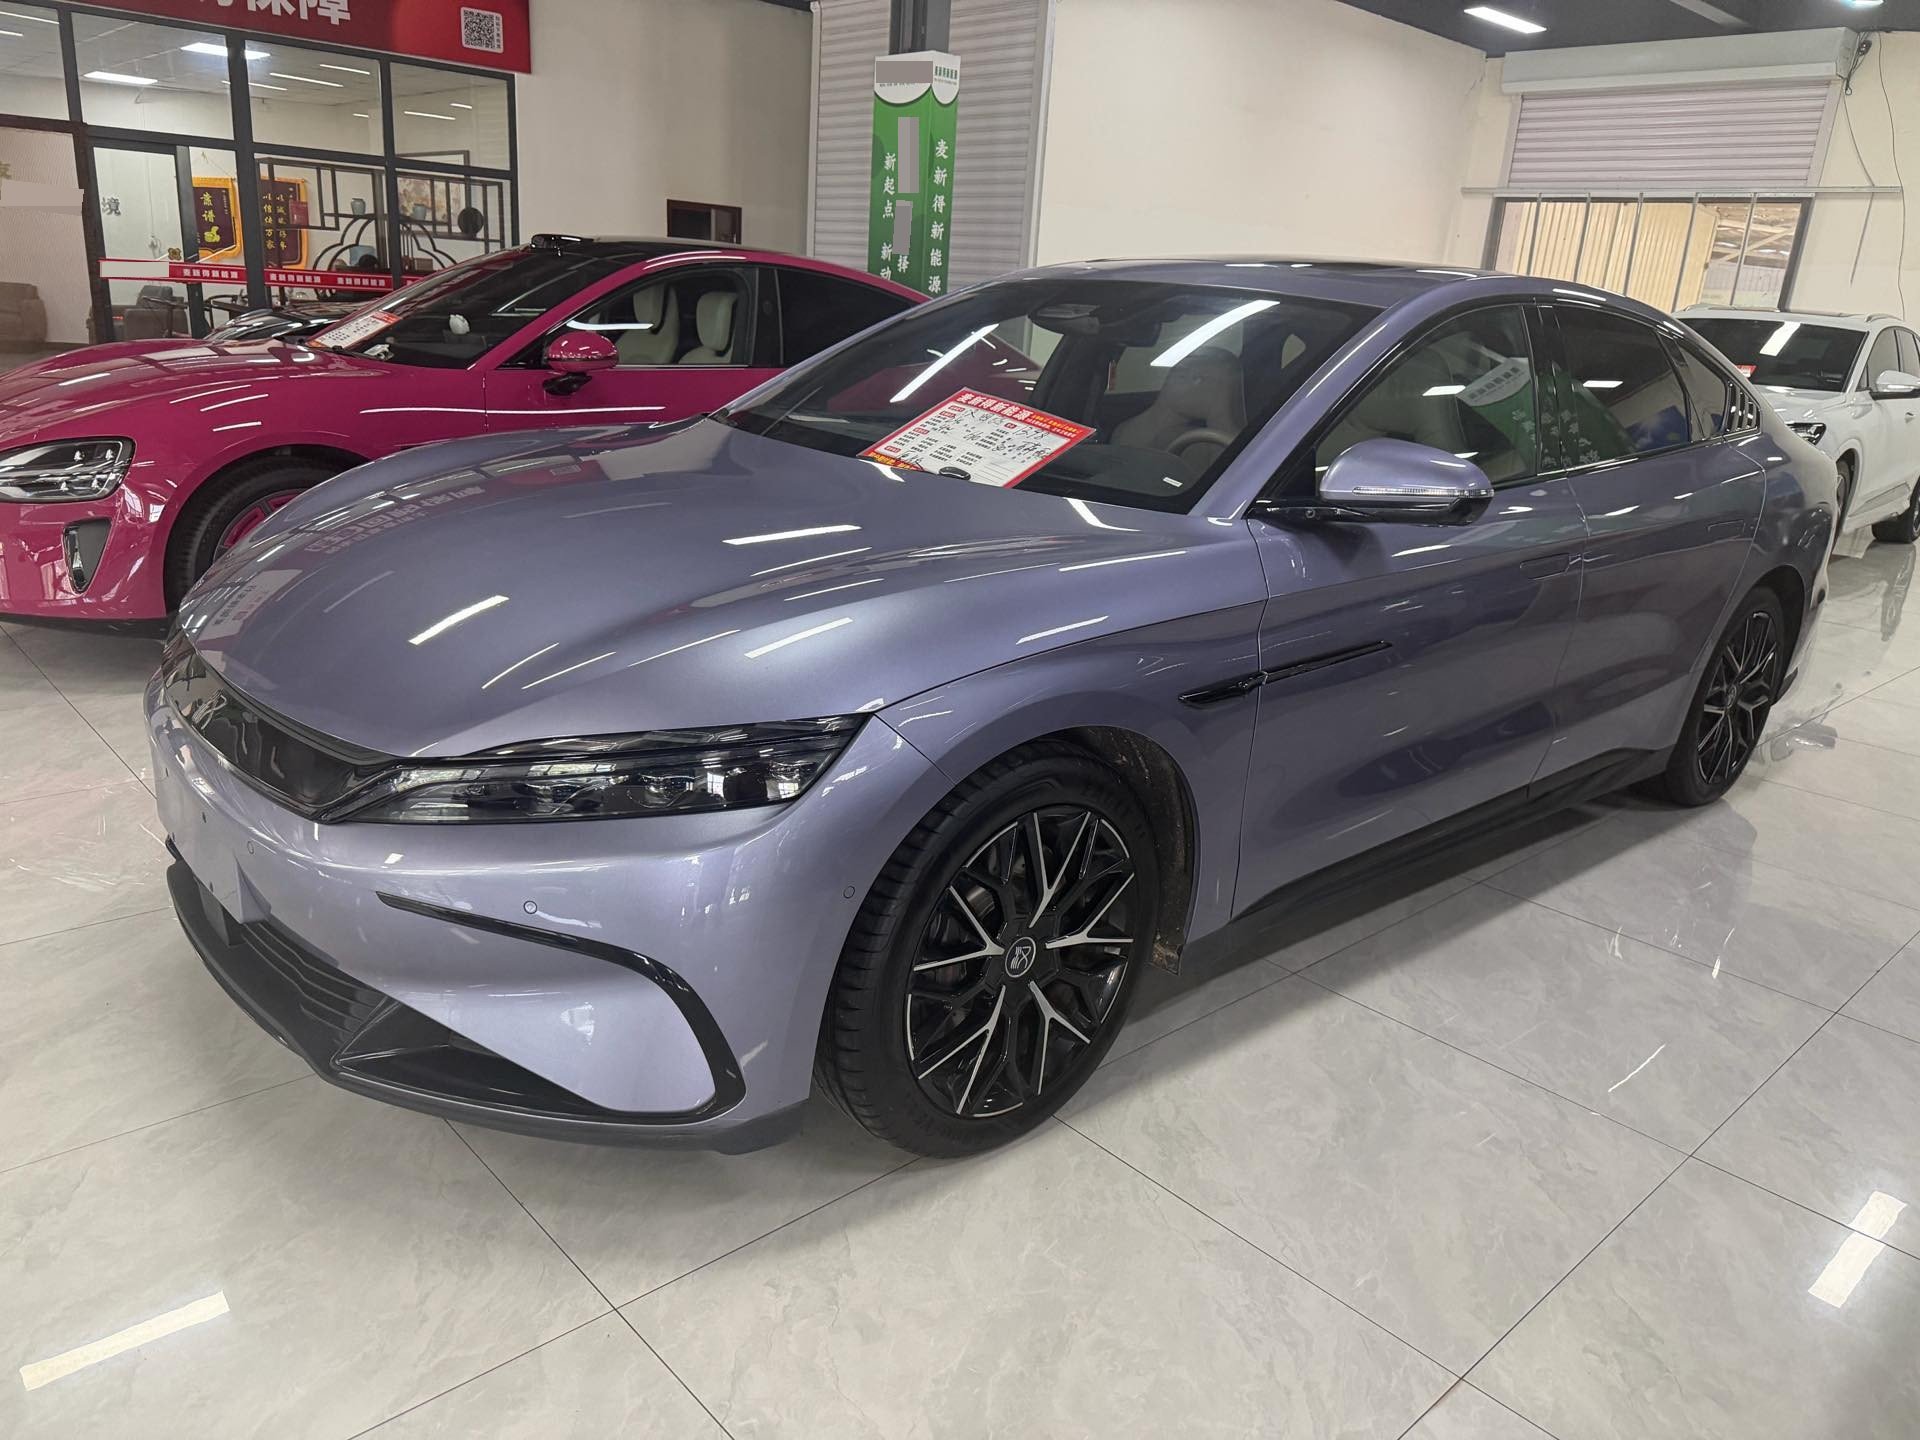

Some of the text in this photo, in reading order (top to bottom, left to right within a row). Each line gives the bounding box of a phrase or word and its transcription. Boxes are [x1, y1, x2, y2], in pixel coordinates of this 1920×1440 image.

[882, 152, 896, 219] 新起点
[928, 139, 949, 294] 麦新得新能源
